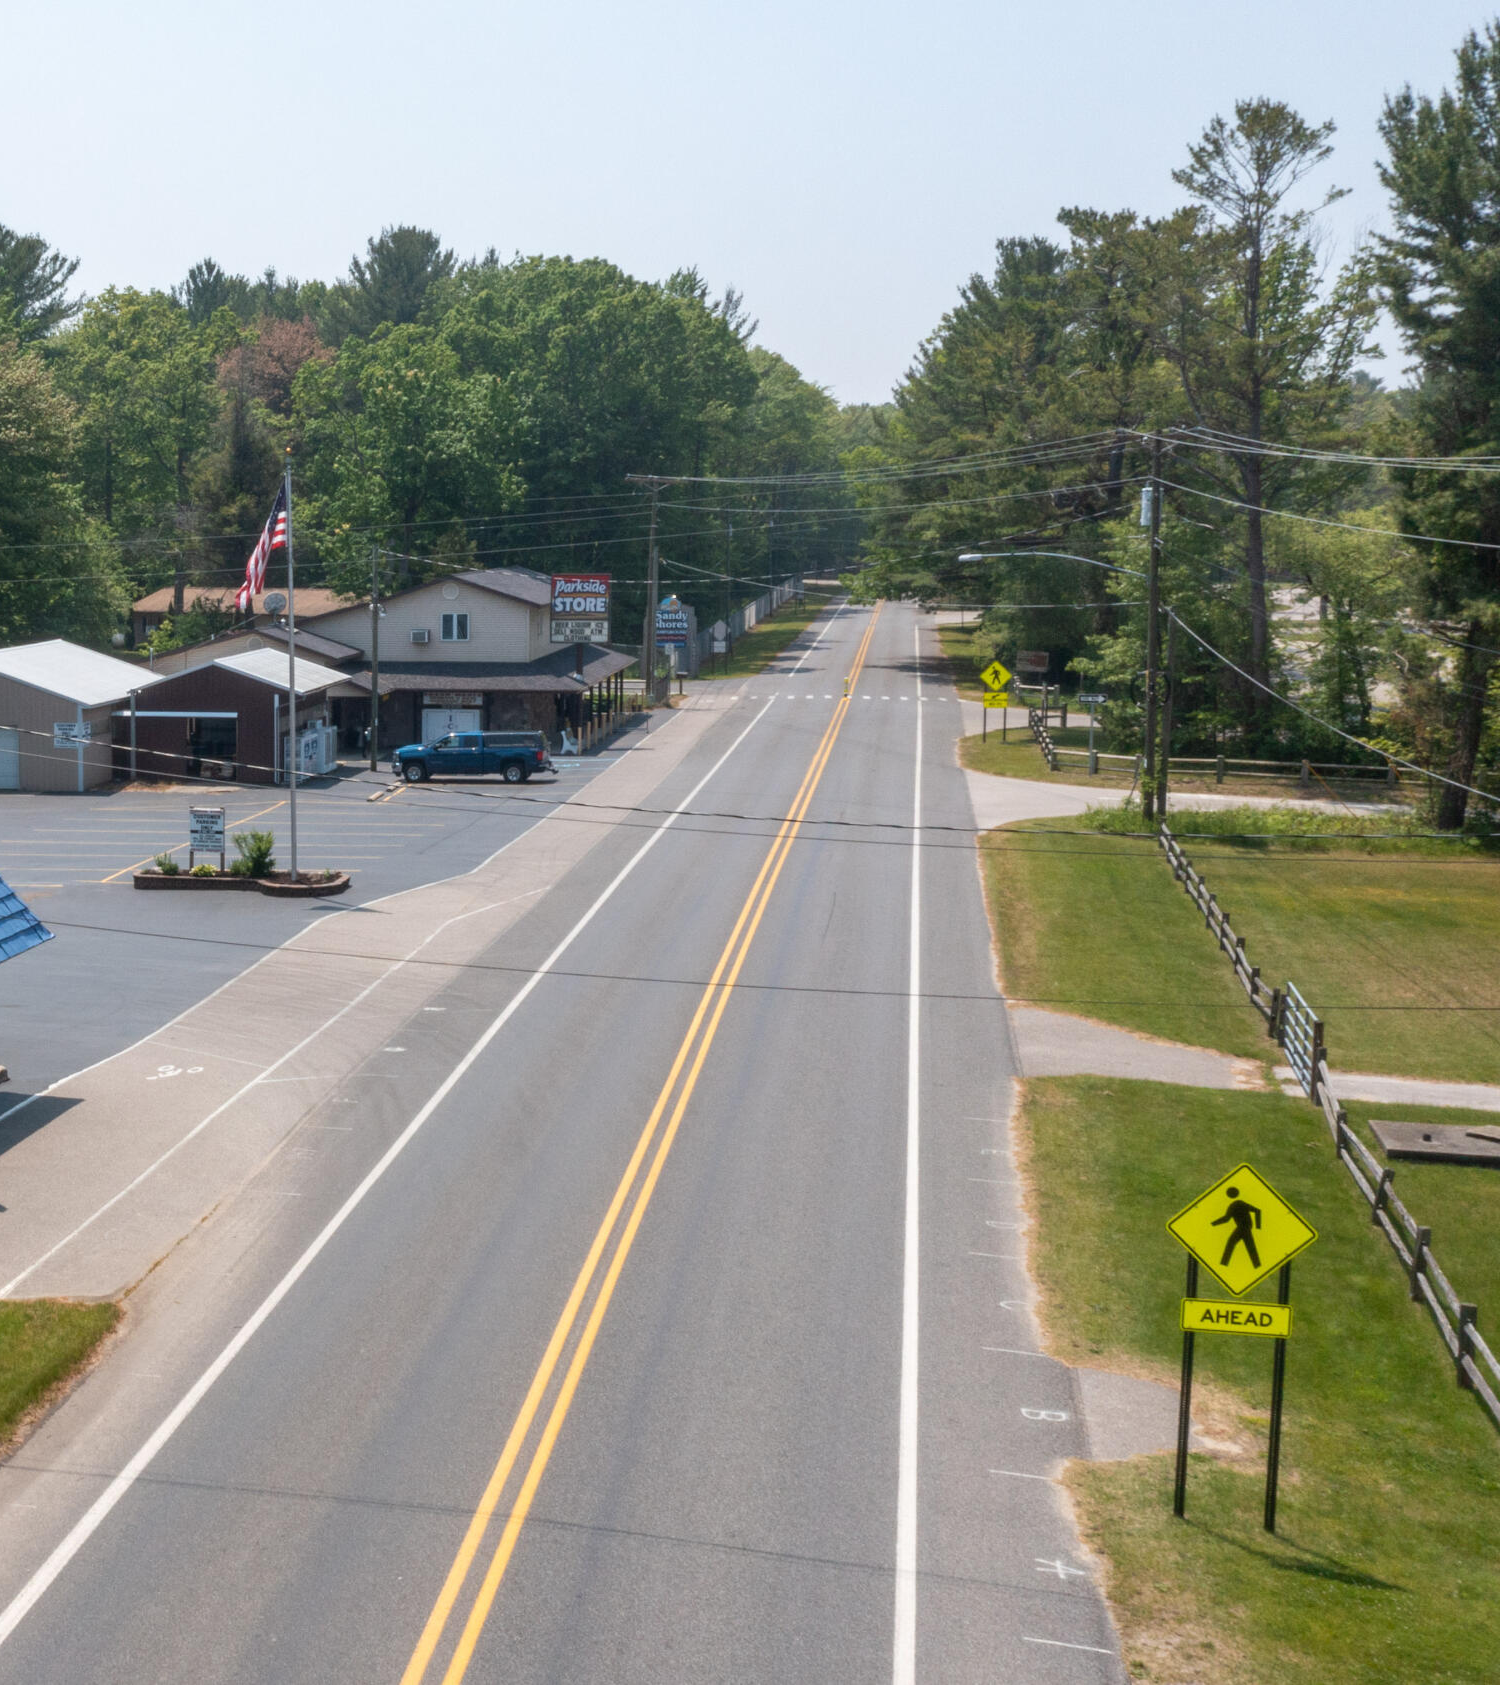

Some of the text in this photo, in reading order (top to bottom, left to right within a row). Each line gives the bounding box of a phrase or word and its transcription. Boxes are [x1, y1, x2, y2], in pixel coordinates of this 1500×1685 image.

[555, 579, 606, 597] Parkside
[555, 597, 606, 612] STORE
[656, 610, 688, 622] Sandy
[1200, 1309, 1273, 1327] AHEAD
